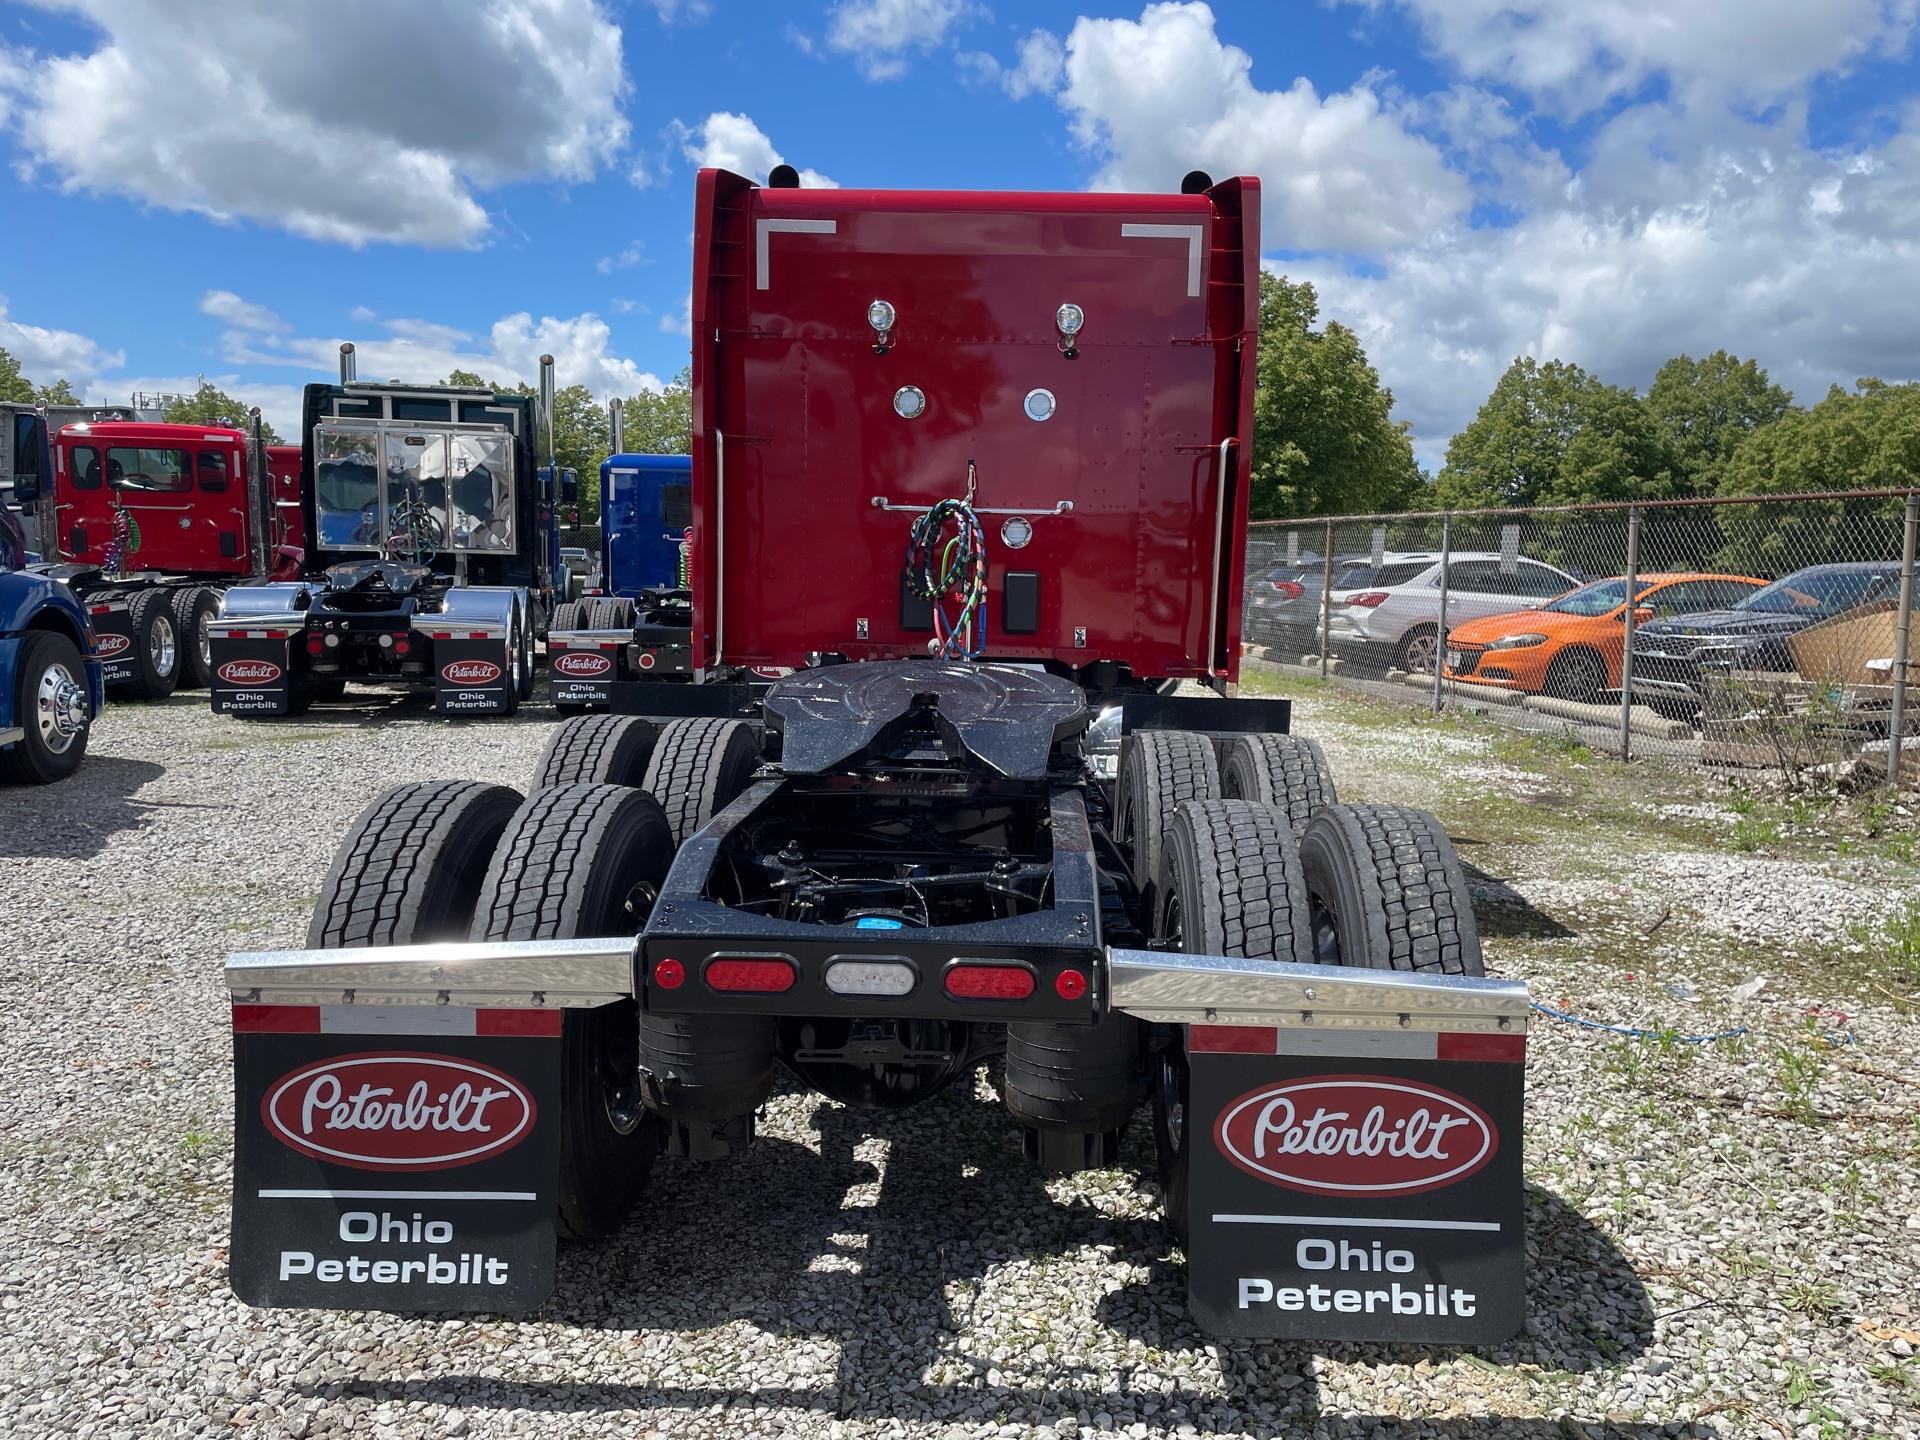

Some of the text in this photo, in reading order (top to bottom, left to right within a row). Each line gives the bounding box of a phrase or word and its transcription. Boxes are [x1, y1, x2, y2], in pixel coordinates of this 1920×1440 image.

[562, 657, 606, 670] Peterbilt
[226, 664, 276, 678] Peterbilt
[449, 664, 496, 678] Peterbilt
[235, 693, 264, 701] Ohio
[459, 692, 485, 700] Ohio
[222, 701, 278, 709] Peterbilt
[446, 700, 498, 708] Peterbilt
[302, 1074, 511, 1135] Peterbilt
[1254, 1097, 1470, 1160] Peterbilt
[339, 1211, 453, 1243] Ohio
[1296, 1238, 1415, 1273] Ohio
[279, 1251, 509, 1285] Peterbilt
[1238, 1278, 1476, 1318] Peterbilt
